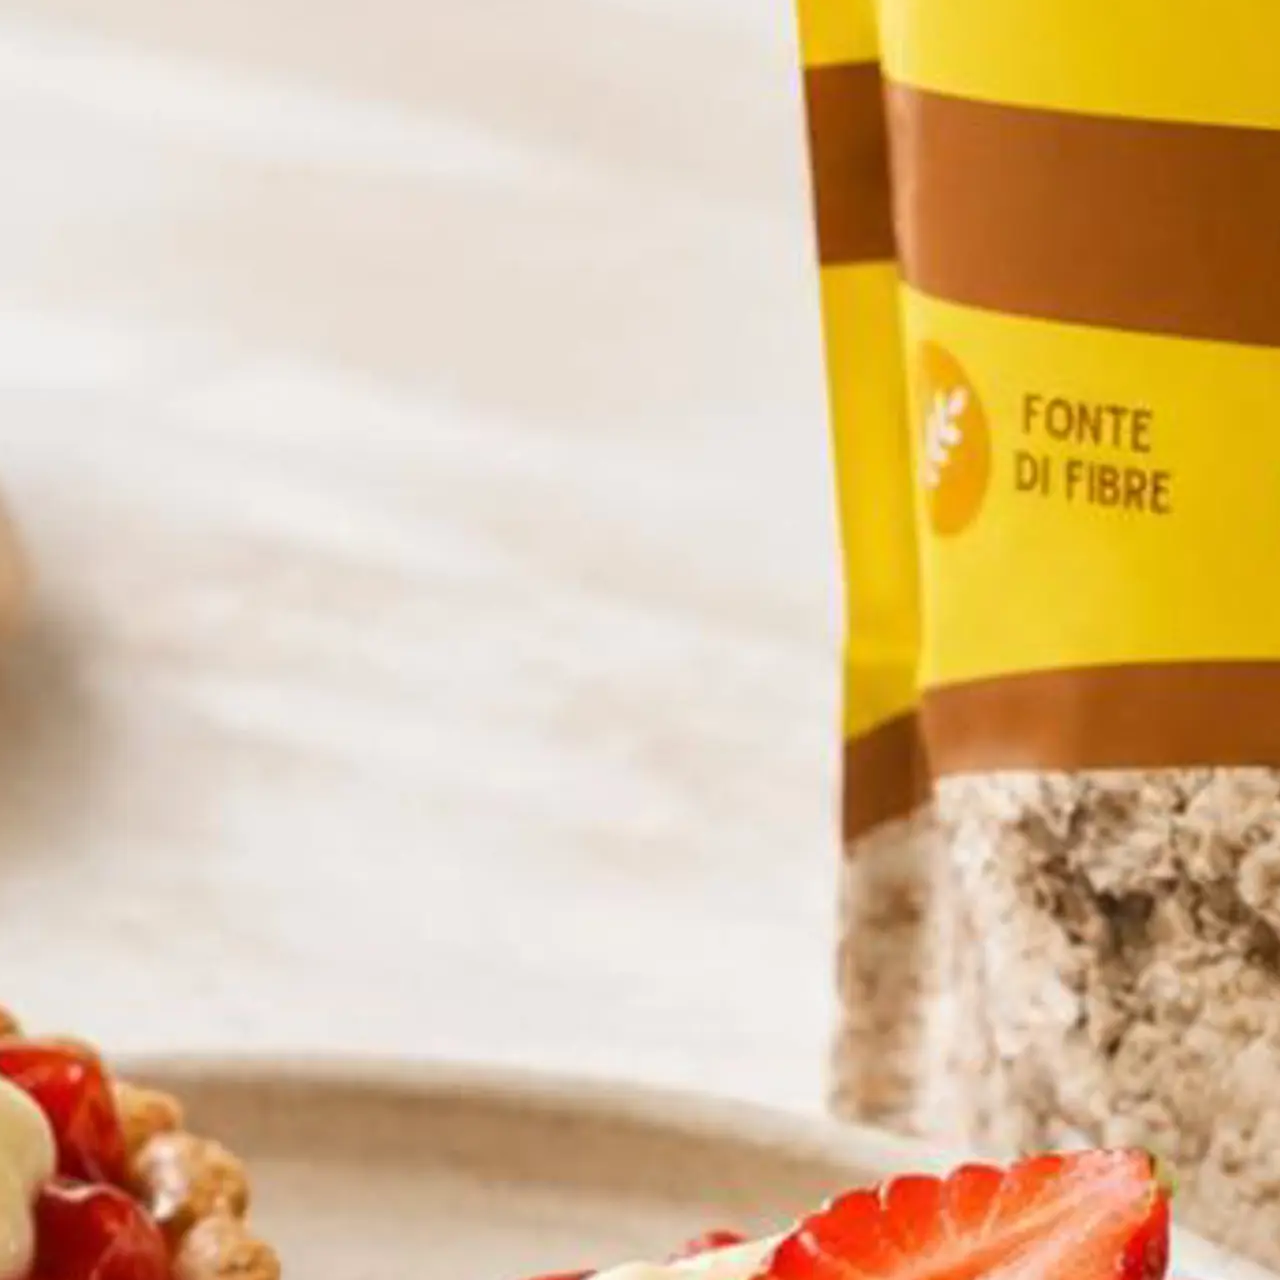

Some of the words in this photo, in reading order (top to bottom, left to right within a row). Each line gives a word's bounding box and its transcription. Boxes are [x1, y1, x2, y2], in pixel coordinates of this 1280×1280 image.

[1022, 393, 1153, 454] FONTE
[1015, 452, 1050, 497] DI
[1065, 460, 1173, 515] FIBRE
